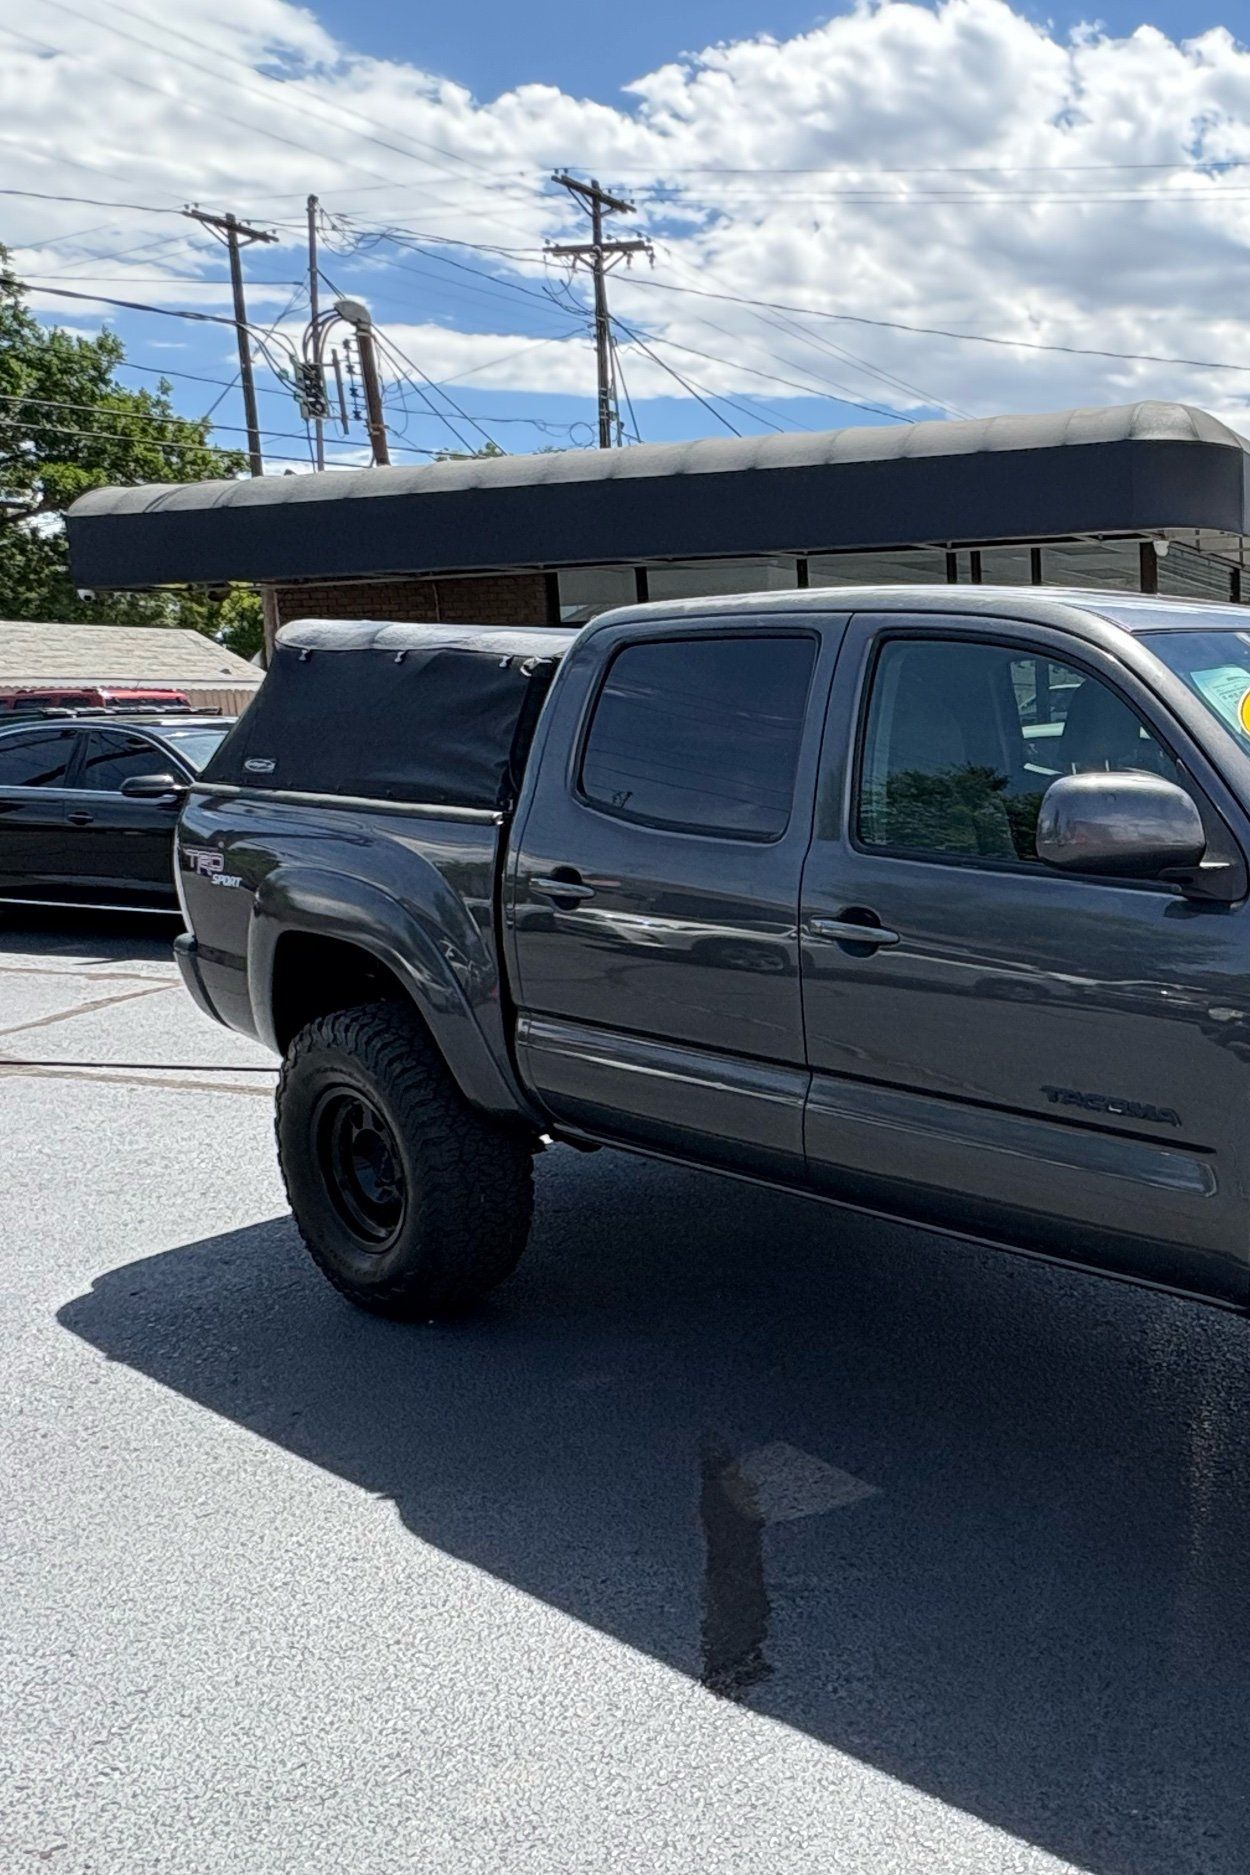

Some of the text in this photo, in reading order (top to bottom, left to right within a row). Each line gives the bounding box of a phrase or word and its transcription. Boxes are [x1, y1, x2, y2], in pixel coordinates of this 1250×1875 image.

[182, 849, 224, 876] TRD
[211, 874, 243, 888] SPORT
[1039, 1085, 1182, 1127] TACOMA
